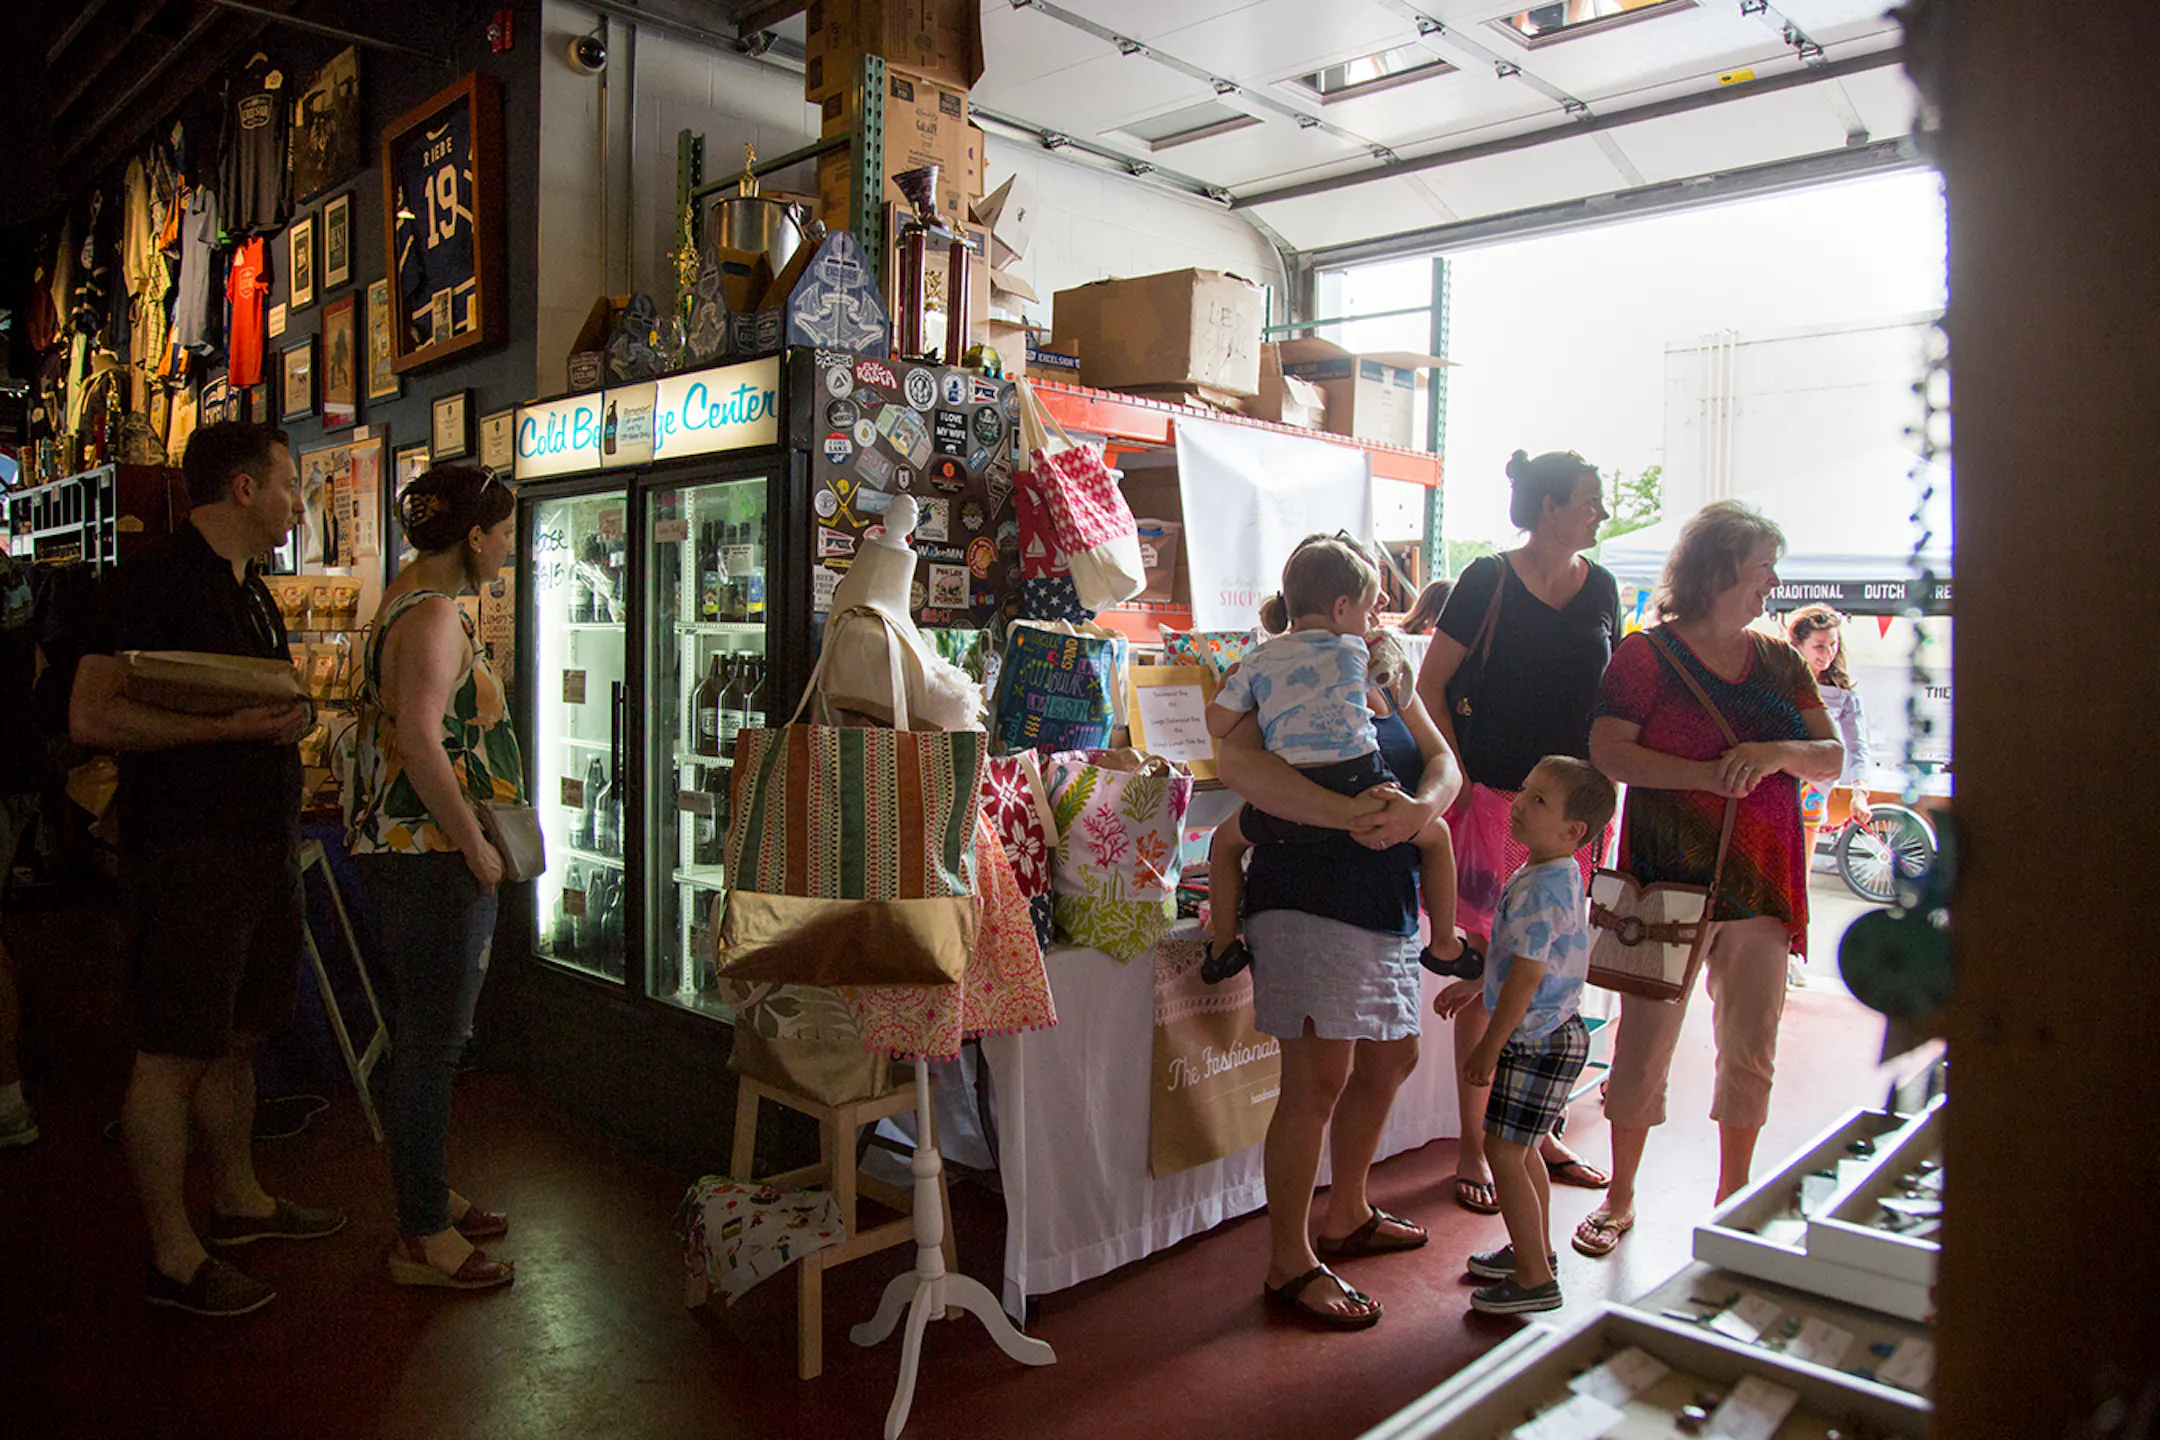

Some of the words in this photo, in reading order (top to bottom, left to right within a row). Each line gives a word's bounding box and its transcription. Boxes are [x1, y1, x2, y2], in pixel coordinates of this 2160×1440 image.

[424, 163, 458, 249] 19
[518, 411, 567, 459] Cold
[682, 382, 777, 431] Center
[1769, 583, 1844, 599] TRADITIONAL
[1864, 583, 1906, 599] DUTCH
[1166, 1057, 1201, 1092] The
